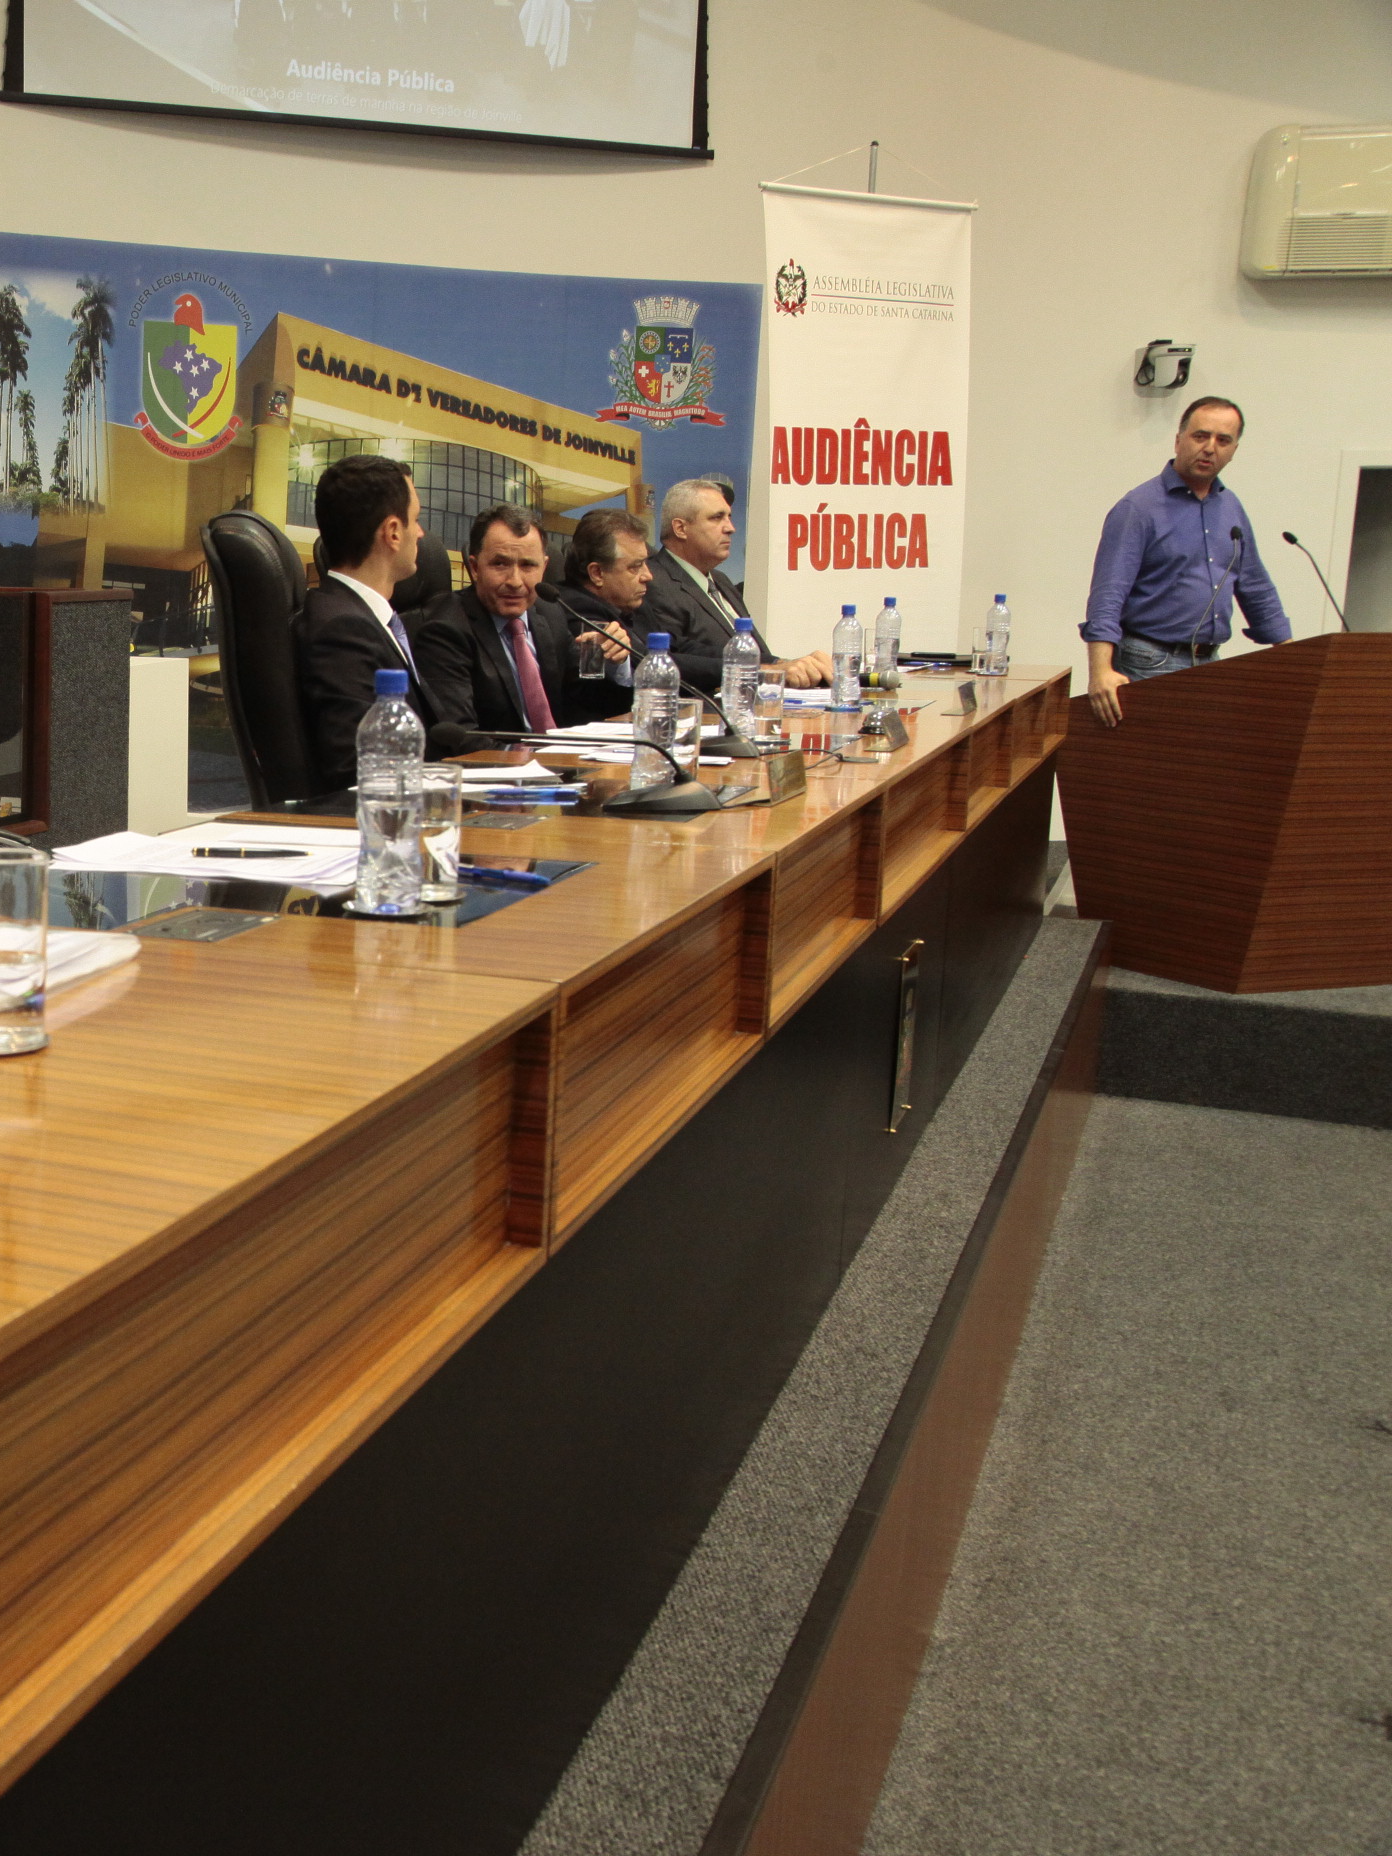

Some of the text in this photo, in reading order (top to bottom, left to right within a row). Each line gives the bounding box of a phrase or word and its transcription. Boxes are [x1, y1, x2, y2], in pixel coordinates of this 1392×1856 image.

[286, 58, 455, 93] Audiência Pública
[288, 87, 303, 101] de
[306, 90, 339, 105] terras
[341, 93, 356, 107] de
[128, 271, 254, 335] PODER LEGISLATIVO MUNICIPAL
[811, 301, 954, 322] DO ESTADO DE SANTA CATARINA
[813, 275, 954, 300] ASSEMBLÉIA LEGISLATIVA
[296, 347, 392, 398] CÂMARA
[426, 388, 538, 438] VEREADORES
[542, 423, 561, 446] DE
[564, 430, 637, 466] JOINVILLE
[771, 417, 953, 487] AUDIÊNCIA
[788, 502, 929, 571] PÚBLICA
